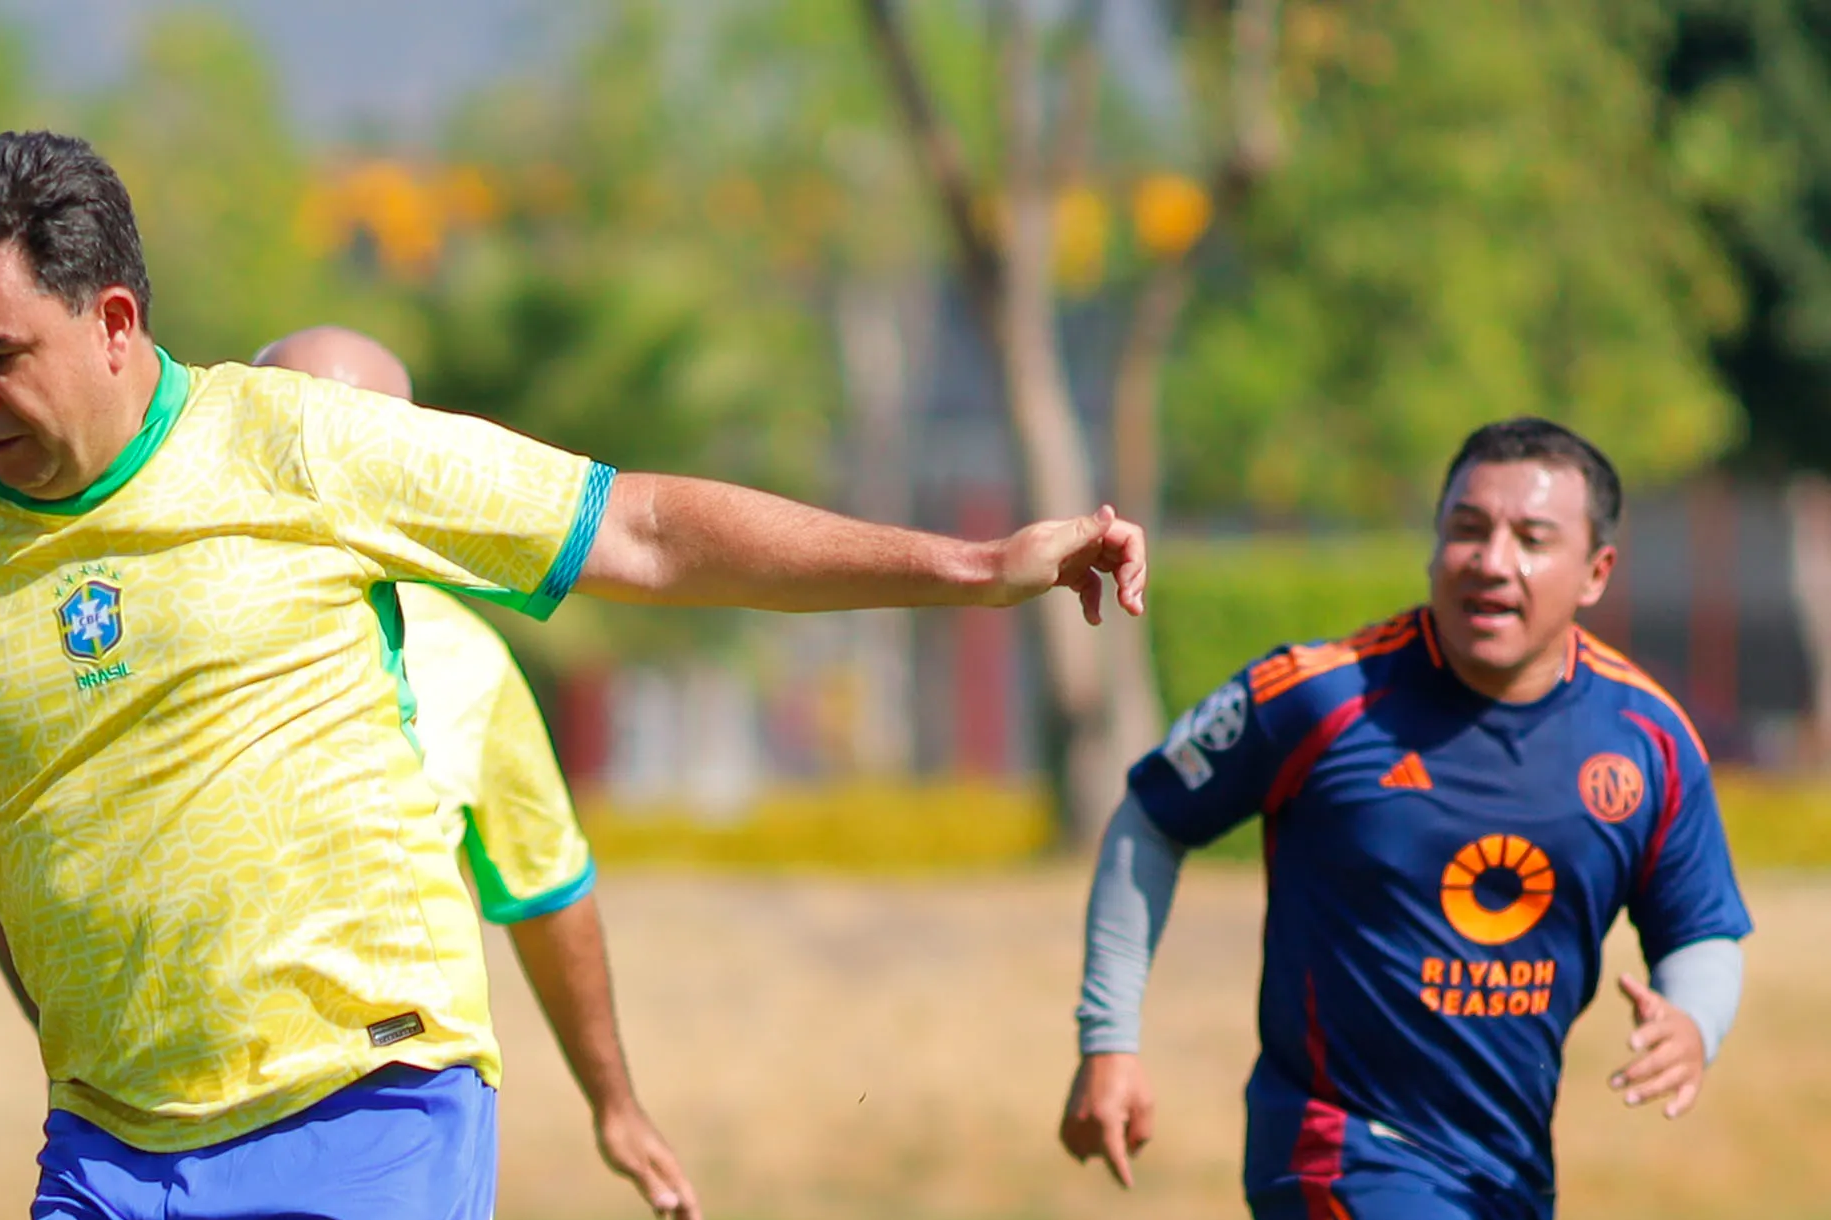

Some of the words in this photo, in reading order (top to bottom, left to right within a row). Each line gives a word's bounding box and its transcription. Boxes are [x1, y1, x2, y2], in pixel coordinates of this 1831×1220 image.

[79, 614, 101, 627] CBF
[76, 661, 132, 690] BRASIL
[1421, 957, 1556, 988] RIYADH
[1420, 987, 1551, 1017] SEASON
